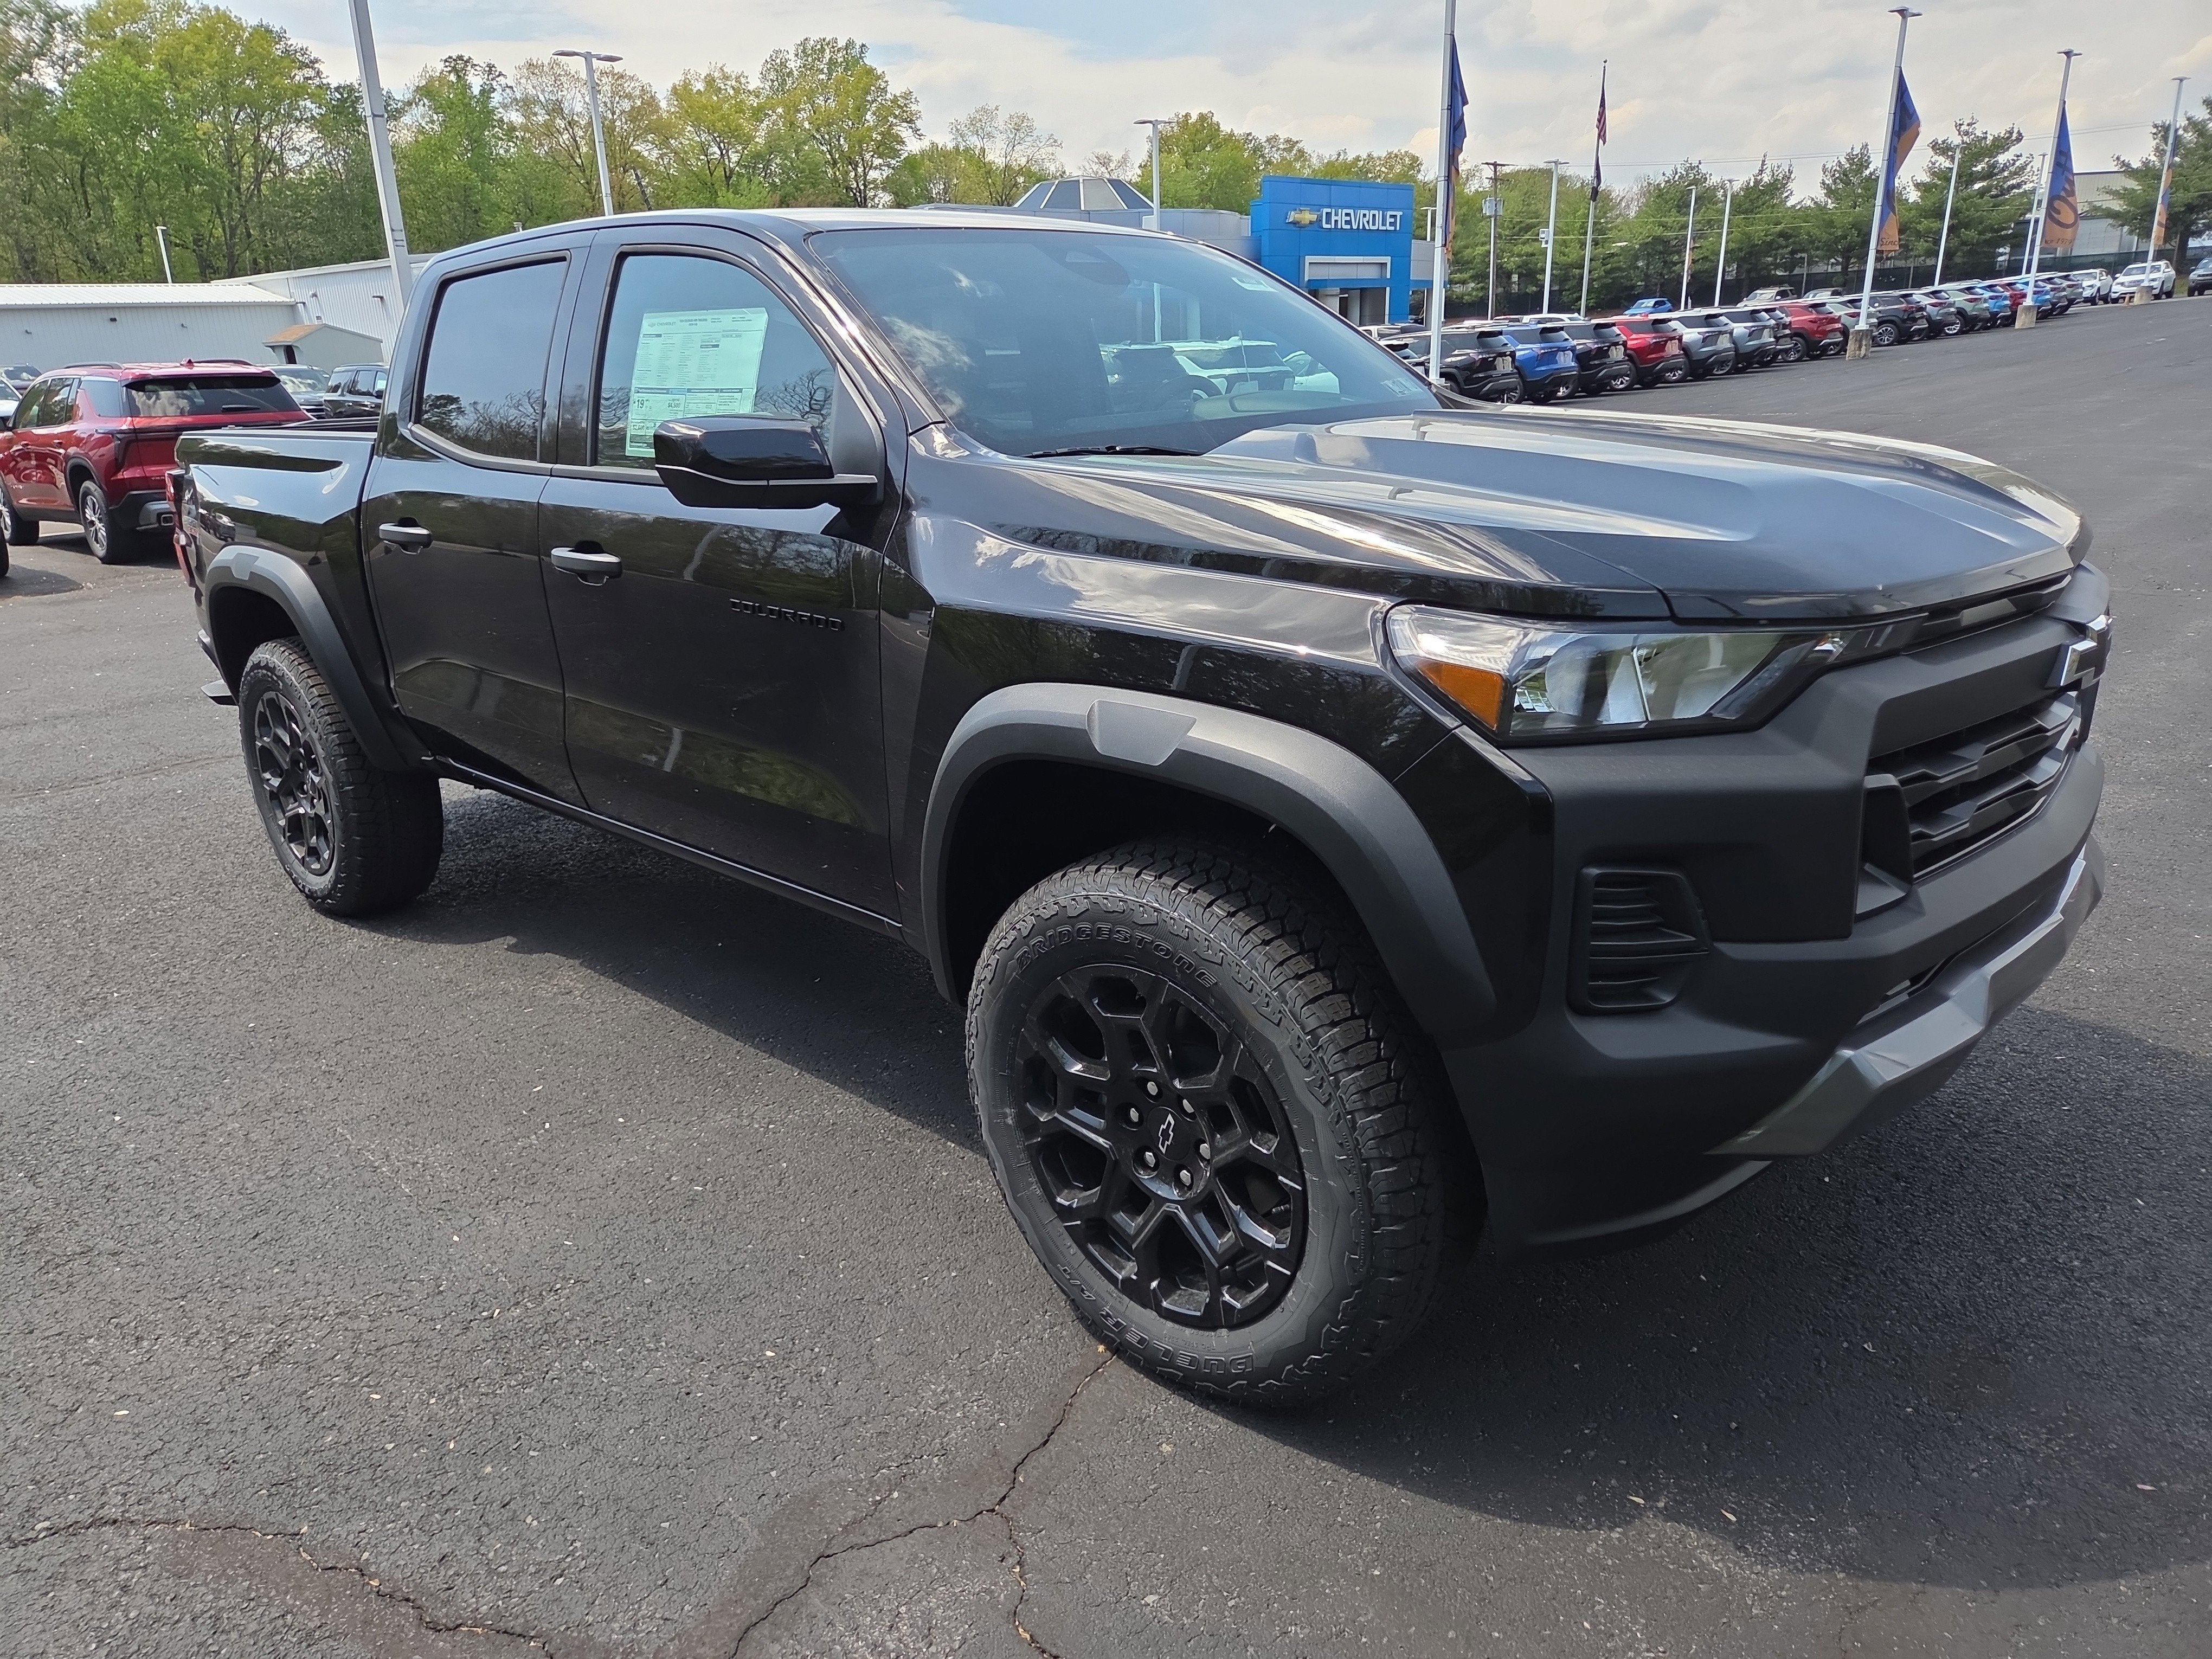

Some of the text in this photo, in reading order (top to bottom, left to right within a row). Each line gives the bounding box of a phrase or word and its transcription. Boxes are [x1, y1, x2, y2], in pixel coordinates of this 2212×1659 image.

[1321, 208, 1403, 230] CHEVROLET
[1880, 237, 1899, 246] Sinc
[1014, 922, 1218, 988] BRIDGESTONE
[1057, 1263, 1096, 1301] A/T
[1098, 1306, 1255, 1374] DUELER
